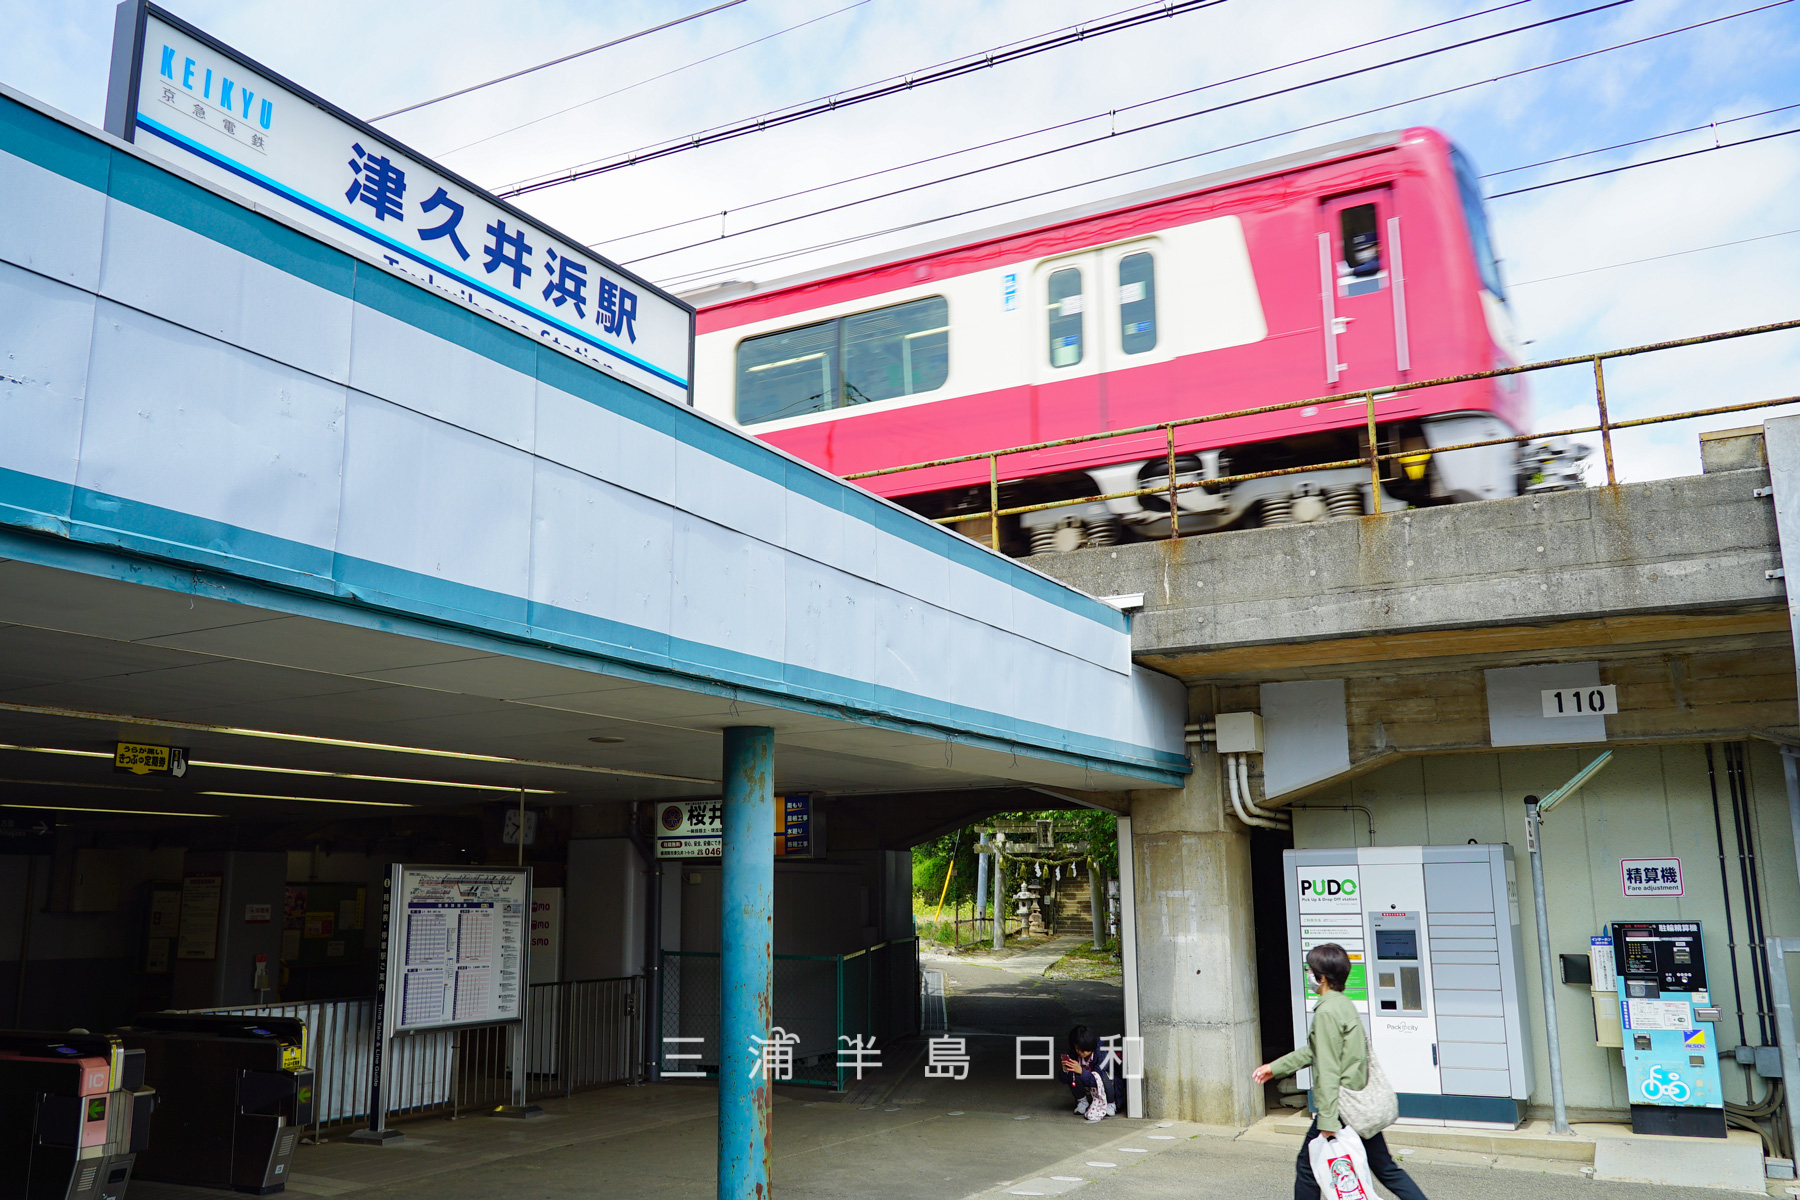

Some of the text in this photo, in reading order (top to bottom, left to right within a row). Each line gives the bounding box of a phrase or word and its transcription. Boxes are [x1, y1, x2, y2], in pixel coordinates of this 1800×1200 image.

[160, 44, 273, 130] KEIKYU
[162, 86, 265, 150] 京急電鉄
[344, 142, 638, 345] 津久井浜駅
[1554, 690, 1605, 713] 110
[1625, 866, 1678, 884] 精算機
[1301, 879, 1357, 896] PUDO
[531, 938, 549, 946] SMO
[88, 1073, 105, 1088] IC
